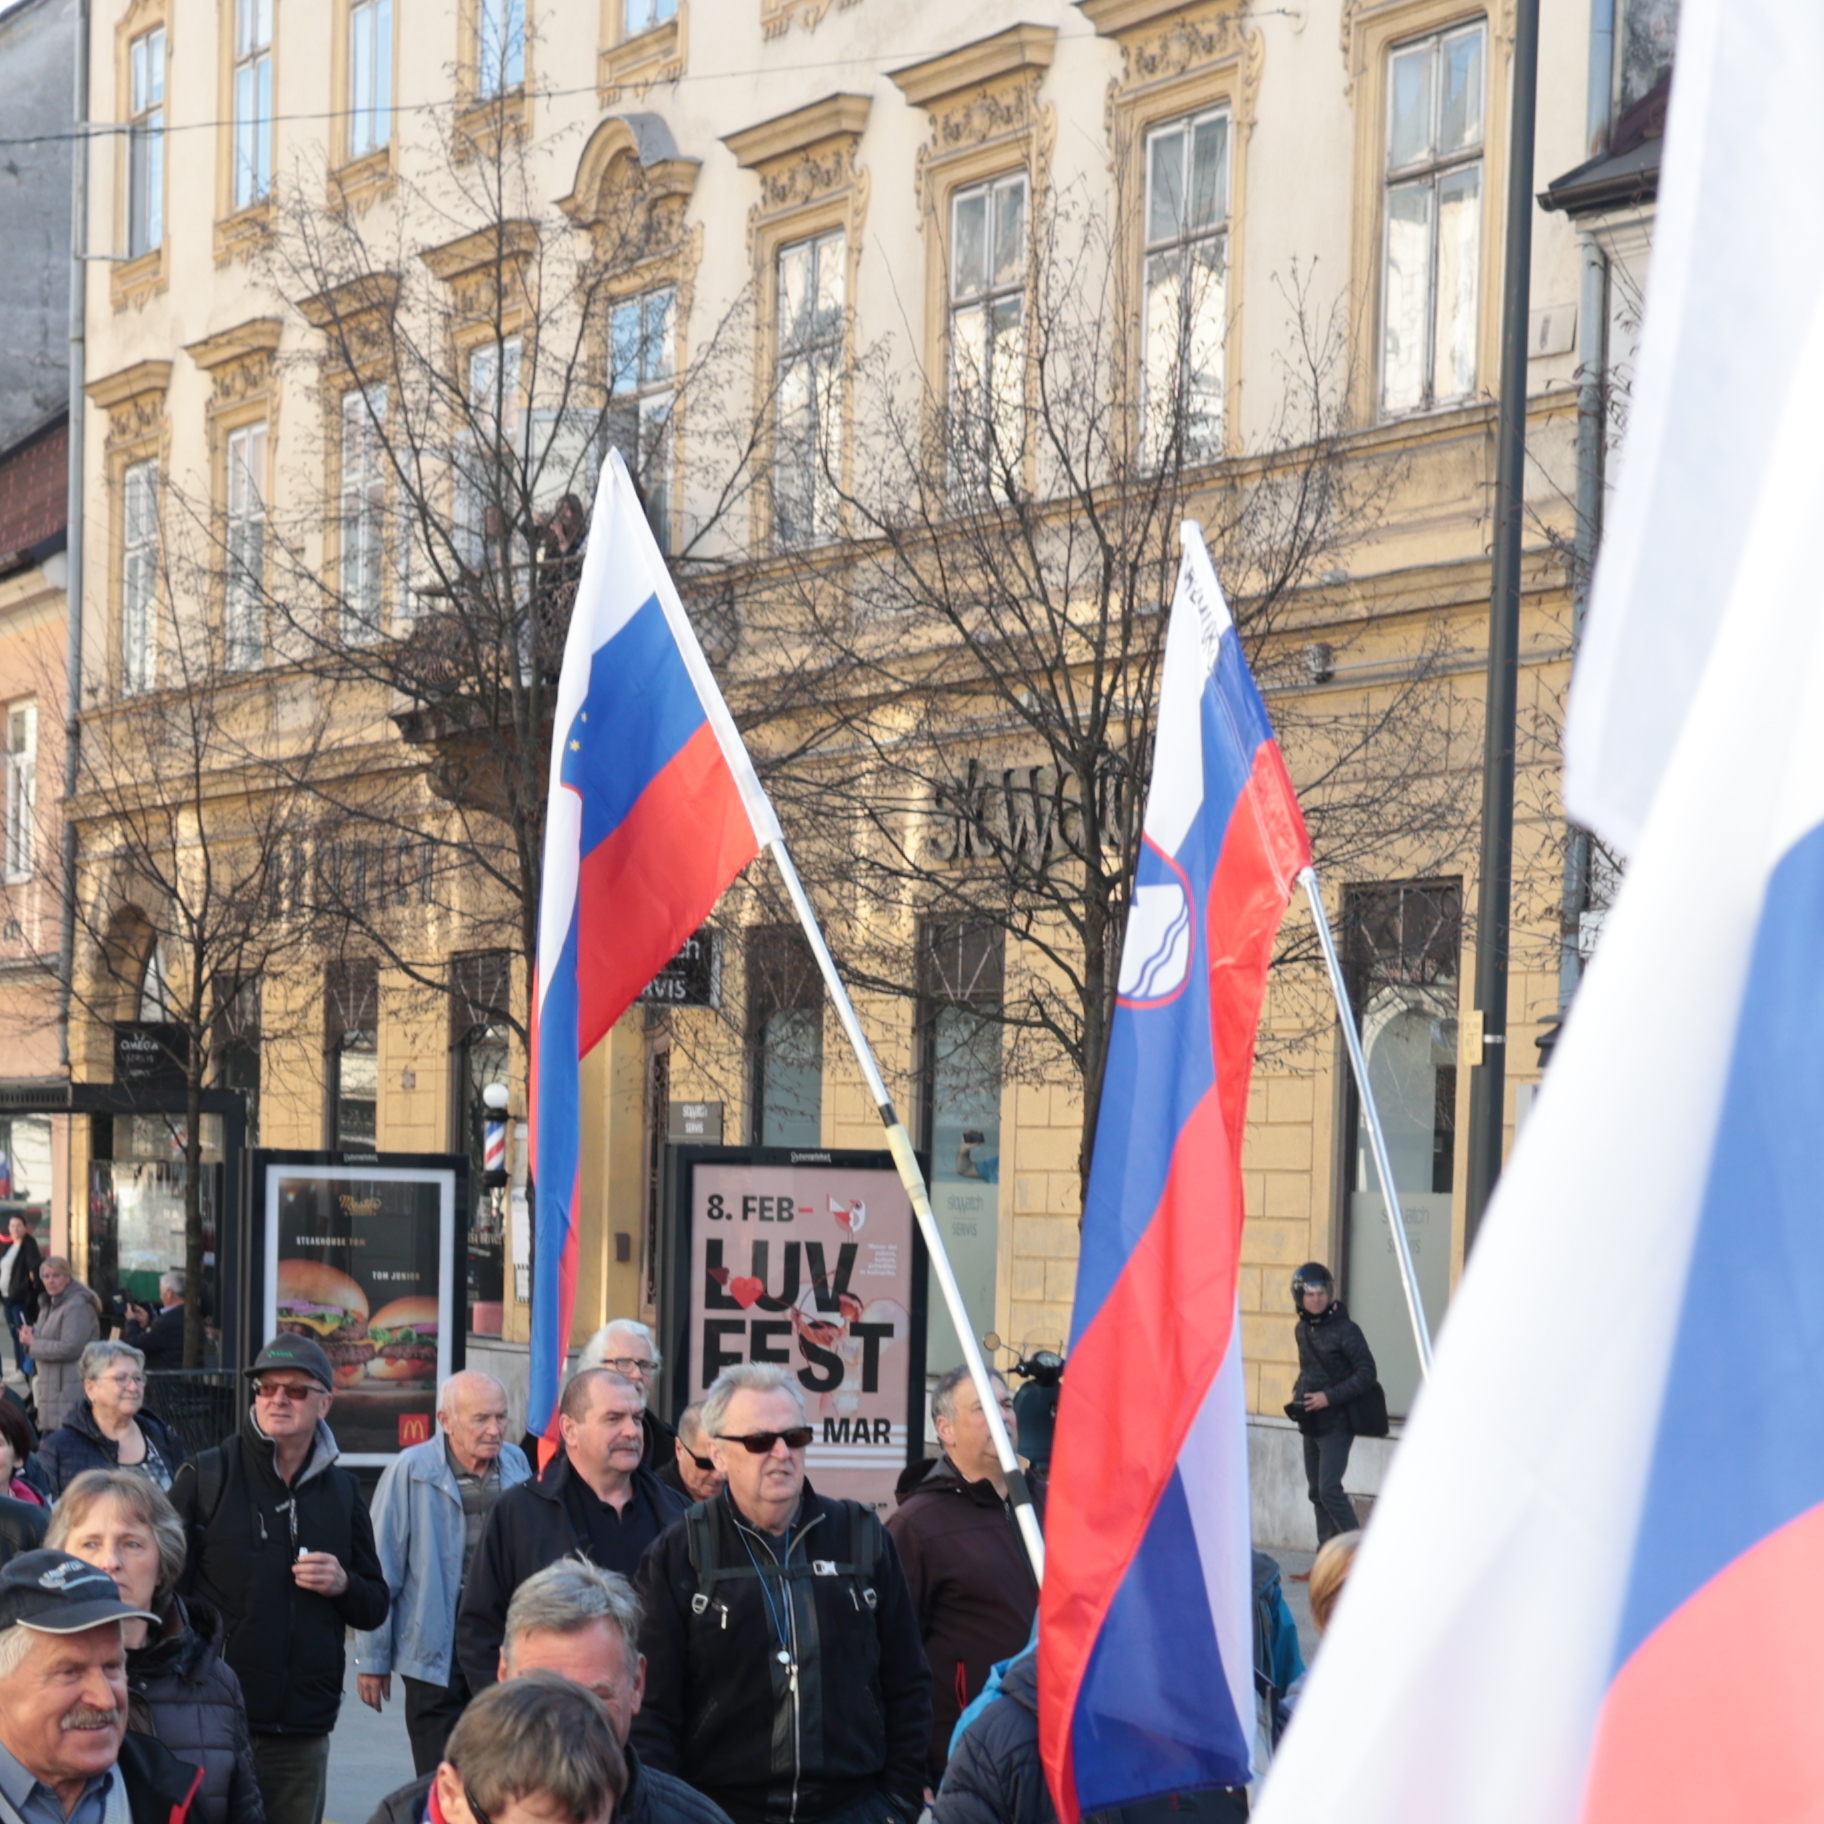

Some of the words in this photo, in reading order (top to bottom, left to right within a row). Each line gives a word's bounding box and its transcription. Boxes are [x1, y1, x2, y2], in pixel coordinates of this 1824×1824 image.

[707, 1194, 733, 1221] 8.
[295, 1236, 347, 1247] STEAKHOUSE
[951, 1221, 978, 1237] SERVIS
[371, 1271, 390, 1281] TOM
[391, 1271, 421, 1282] JUNIOR
[704, 1238, 859, 1313] LUV
[702, 1318, 895, 1394] FEST
[822, 1416, 892, 1444] MAR
